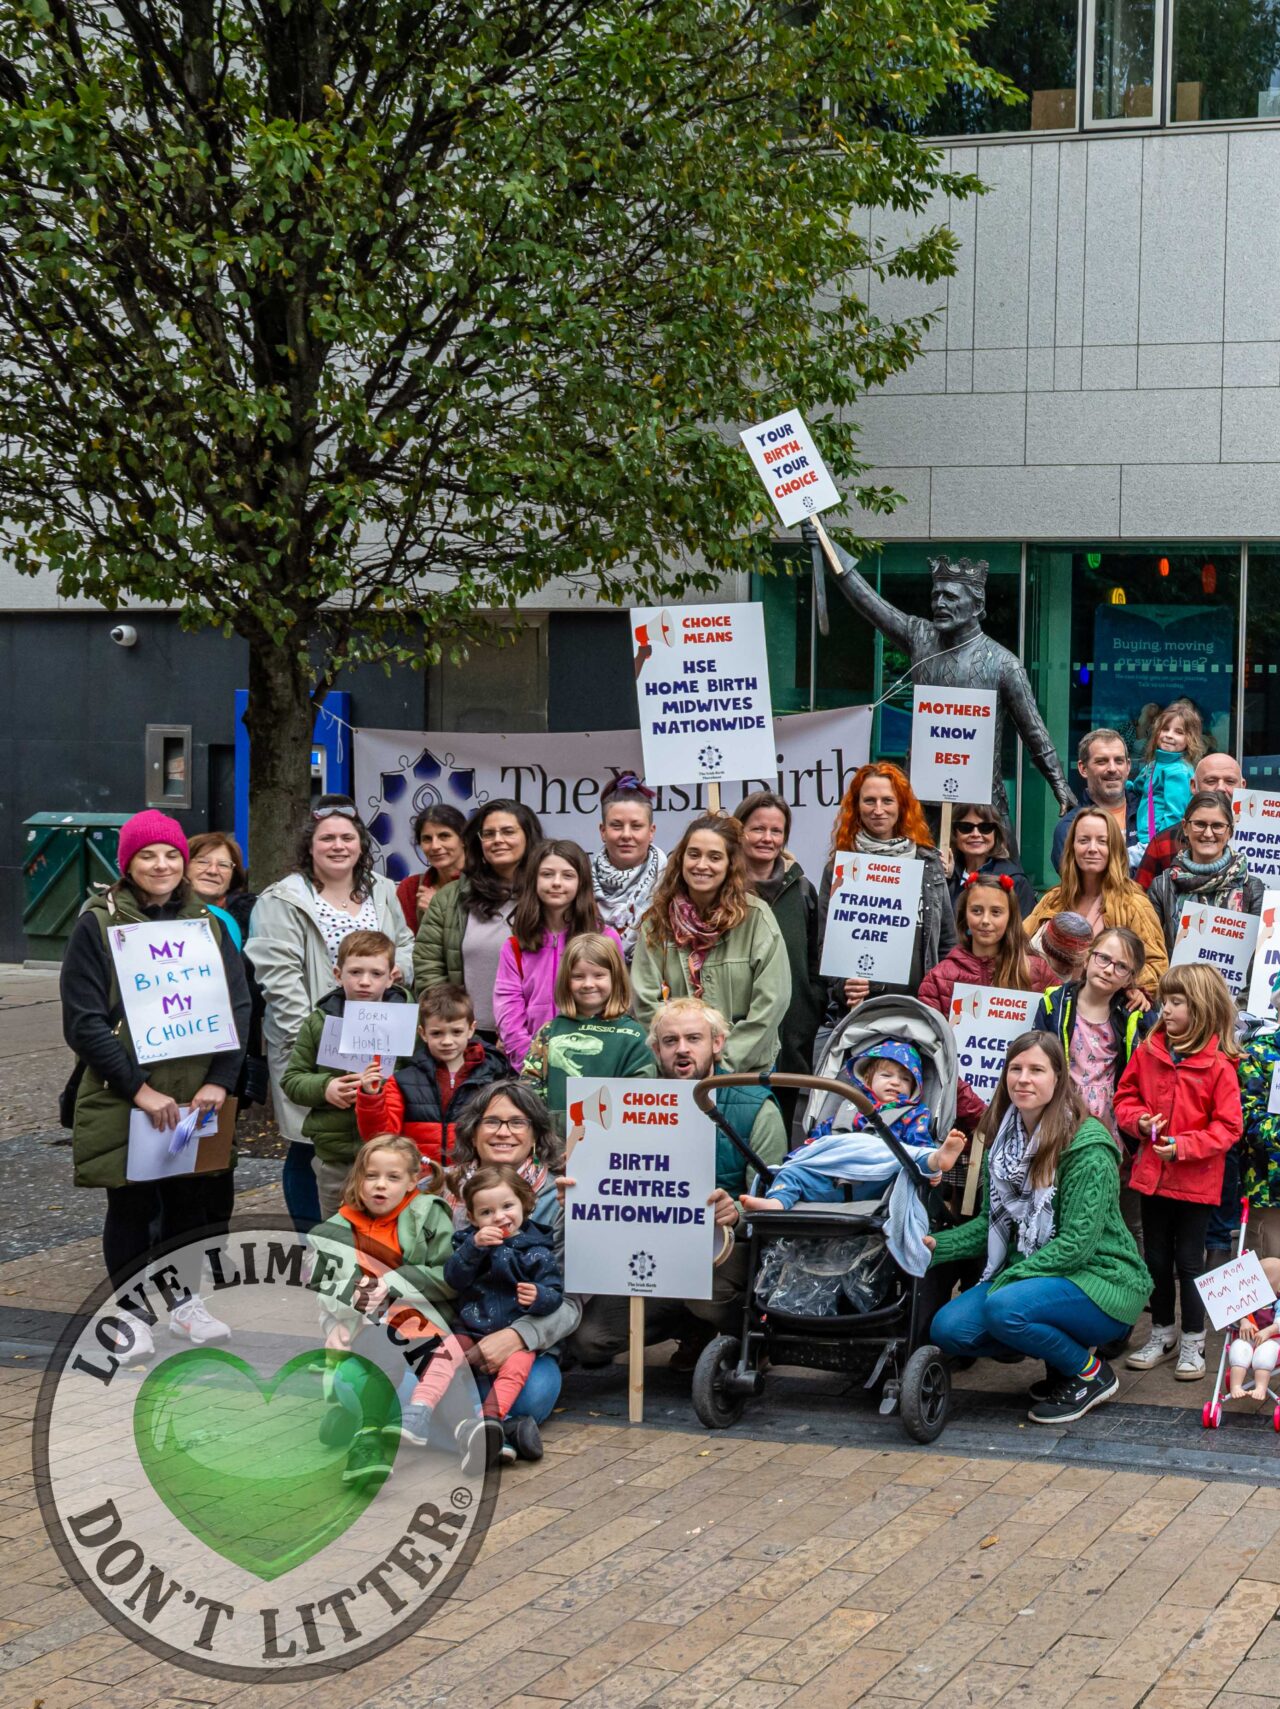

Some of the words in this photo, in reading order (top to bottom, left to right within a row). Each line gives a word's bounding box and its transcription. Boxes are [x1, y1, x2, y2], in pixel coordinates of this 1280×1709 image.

[756, 423, 794, 447] YOUR
[772, 456, 810, 479] YOUR
[774, 470, 819, 499] CHOICE
[682, 616, 732, 628] CHOICE
[683, 632, 733, 644] MEANS
[1112, 638, 1162, 652] Buying,
[1165, 640, 1214, 654] moving
[683, 660, 717, 674] HSE
[645, 680, 699, 695] HOME
[707, 677, 757, 692] BIRTH
[662, 697, 752, 714] MIDWIVES
[918, 702, 991, 717] MOTHERS
[652, 716, 765, 735] NATIONWIDE
[930, 726, 977, 740] KNOW
[935, 752, 970, 765] BEST
[501, 764, 598, 815] The
[867, 863, 901, 873] CHOICE
[866, 874, 900, 884] MEANS
[840, 893, 902, 910] TRAUMA
[833, 909, 910, 927] INFORMED
[1214, 916, 1247, 929] CHOICE
[851, 928, 888, 942] CARE
[1211, 926, 1245, 939] MEANS
[149, 940, 185, 960] MY
[1198, 948, 1235, 965] BIRTH
[134, 964, 211, 991] BIRTH
[989, 997, 1028, 1009] CHOICE
[988, 1009, 1026, 1021] MEANS
[146, 1014, 219, 1046] CHOICE
[363, 1023, 376, 1032] AT
[352, 1035, 391, 1052] HOME!
[957, 1054, 973, 1066] O
[622, 1092, 679, 1107] CHOICE
[622, 1111, 679, 1125] MEANS
[609, 1152, 670, 1172] BIRTH
[598, 1178, 690, 1198] CENTRES
[571, 1203, 706, 1225] NATIONWIDE
